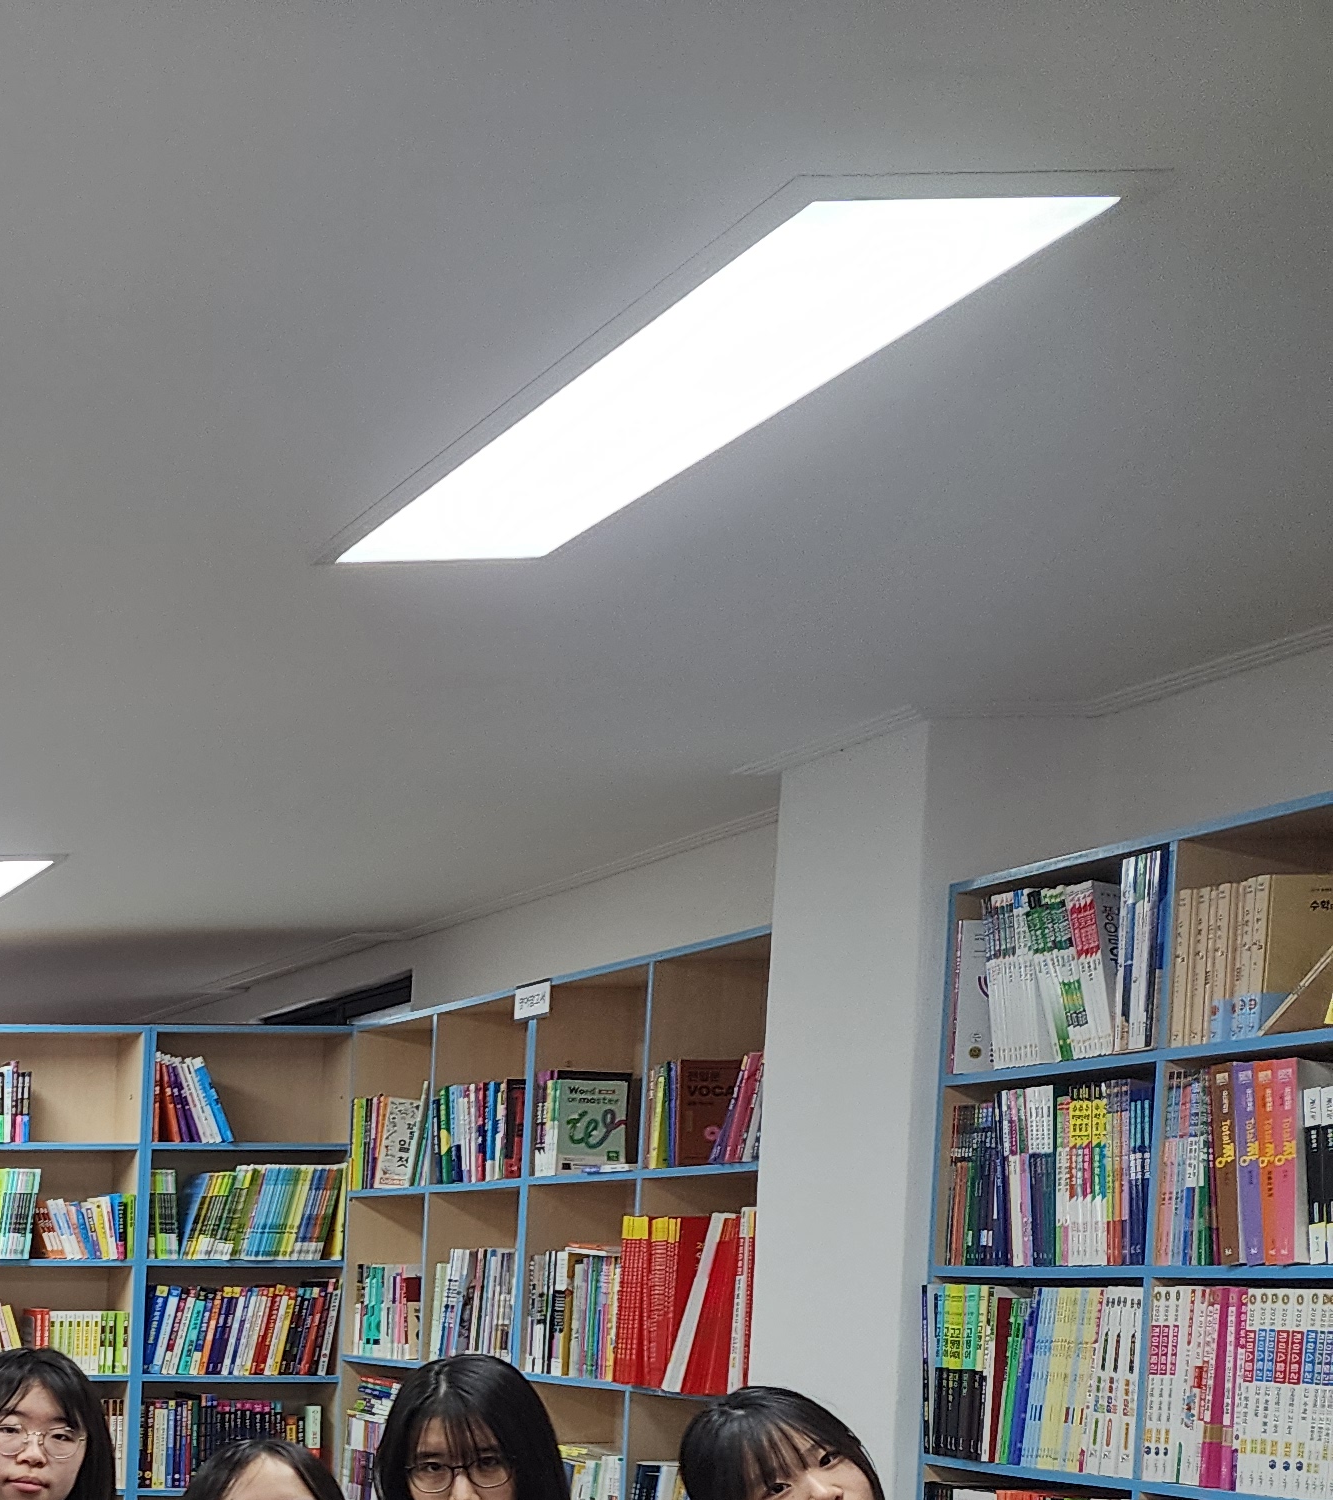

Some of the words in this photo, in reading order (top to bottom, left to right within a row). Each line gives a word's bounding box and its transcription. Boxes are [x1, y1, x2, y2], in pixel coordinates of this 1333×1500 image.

[567, 1086, 596, 1095] Word
[1150, 1326, 1160, 1373] 자이스토리
[1244, 1331, 1255, 1381] 자이스토리
[1256, 1330, 1266, 1381] 자이스토리
[1275, 1332, 1288, 1382] 자이스토리
[1290, 1332, 1302, 1383] 자이스토리
[1304, 1331, 1317, 1383] 자이스토리
